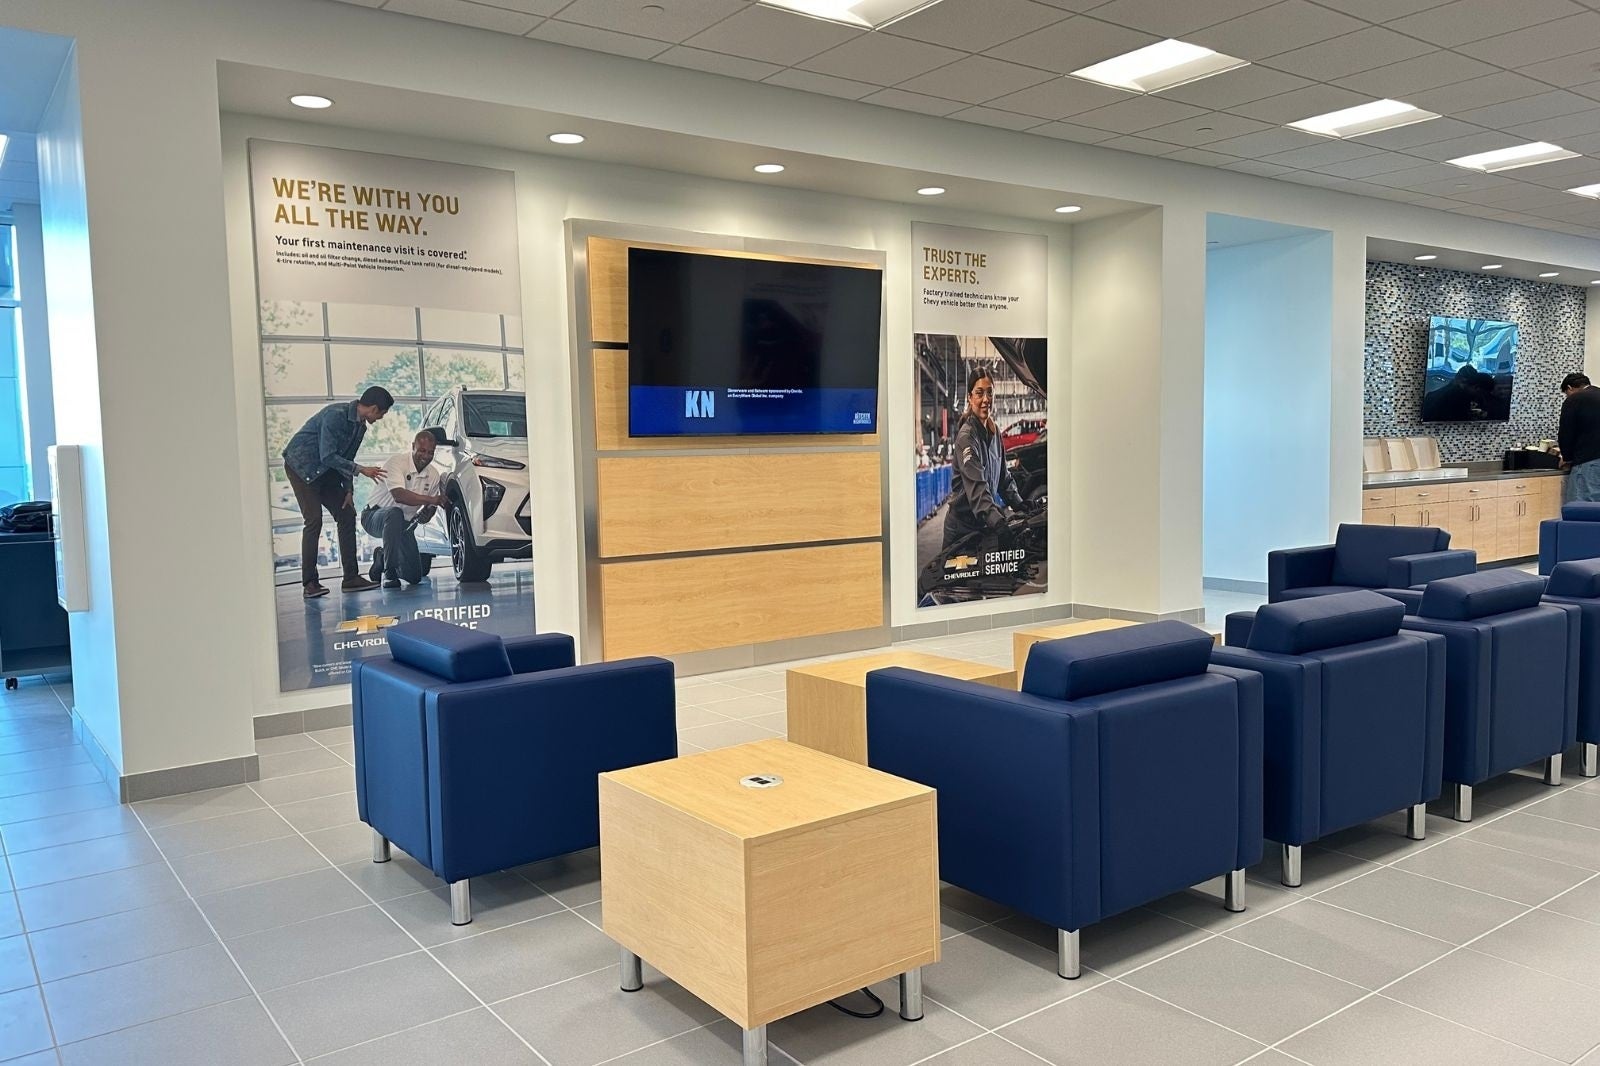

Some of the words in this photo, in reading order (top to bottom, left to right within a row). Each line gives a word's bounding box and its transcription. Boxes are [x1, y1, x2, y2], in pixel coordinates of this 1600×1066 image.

[272, 177, 347, 204] WE’RE
[352, 185, 411, 210] WITH
[417, 192, 460, 215] YOU
[275, 204, 319, 226] ALL
[325, 207, 369, 231] THE
[375, 212, 428, 236] WAY.
[275, 235, 300, 246] Your
[302, 237, 325, 248] first
[327, 240, 392, 253] maintenance
[394, 245, 415, 255] visit
[417, 247, 425, 256] is
[275, 250, 300, 258] Includes:
[341, 255, 362, 263] change,
[445, 264, 483, 273] diesel-equipped
[923, 247, 961, 265] TRUST
[964, 252, 987, 267] THE
[328, 261, 357, 269] Multi-Point
[377, 264, 405, 273] Inspection.
[923, 265, 980, 285] EXPERTS.
[923, 288, 944, 298] Factory
[944, 290, 964, 299] trained
[964, 292, 993, 302] technicians
[993, 294, 1007, 302] know
[923, 297, 940, 307] Chevy
[940, 300, 959, 308] vehicle
[959, 300, 976, 309] better
[989, 303, 1009, 311] anyone.
[685, 390, 715, 418] KN
[985, 549, 1025, 562] CERTIFIED
[944, 571, 980, 580] CHEVROLET
[985, 561, 1018, 575] SERVICE
[333, 638, 388, 650] CHEVROL
